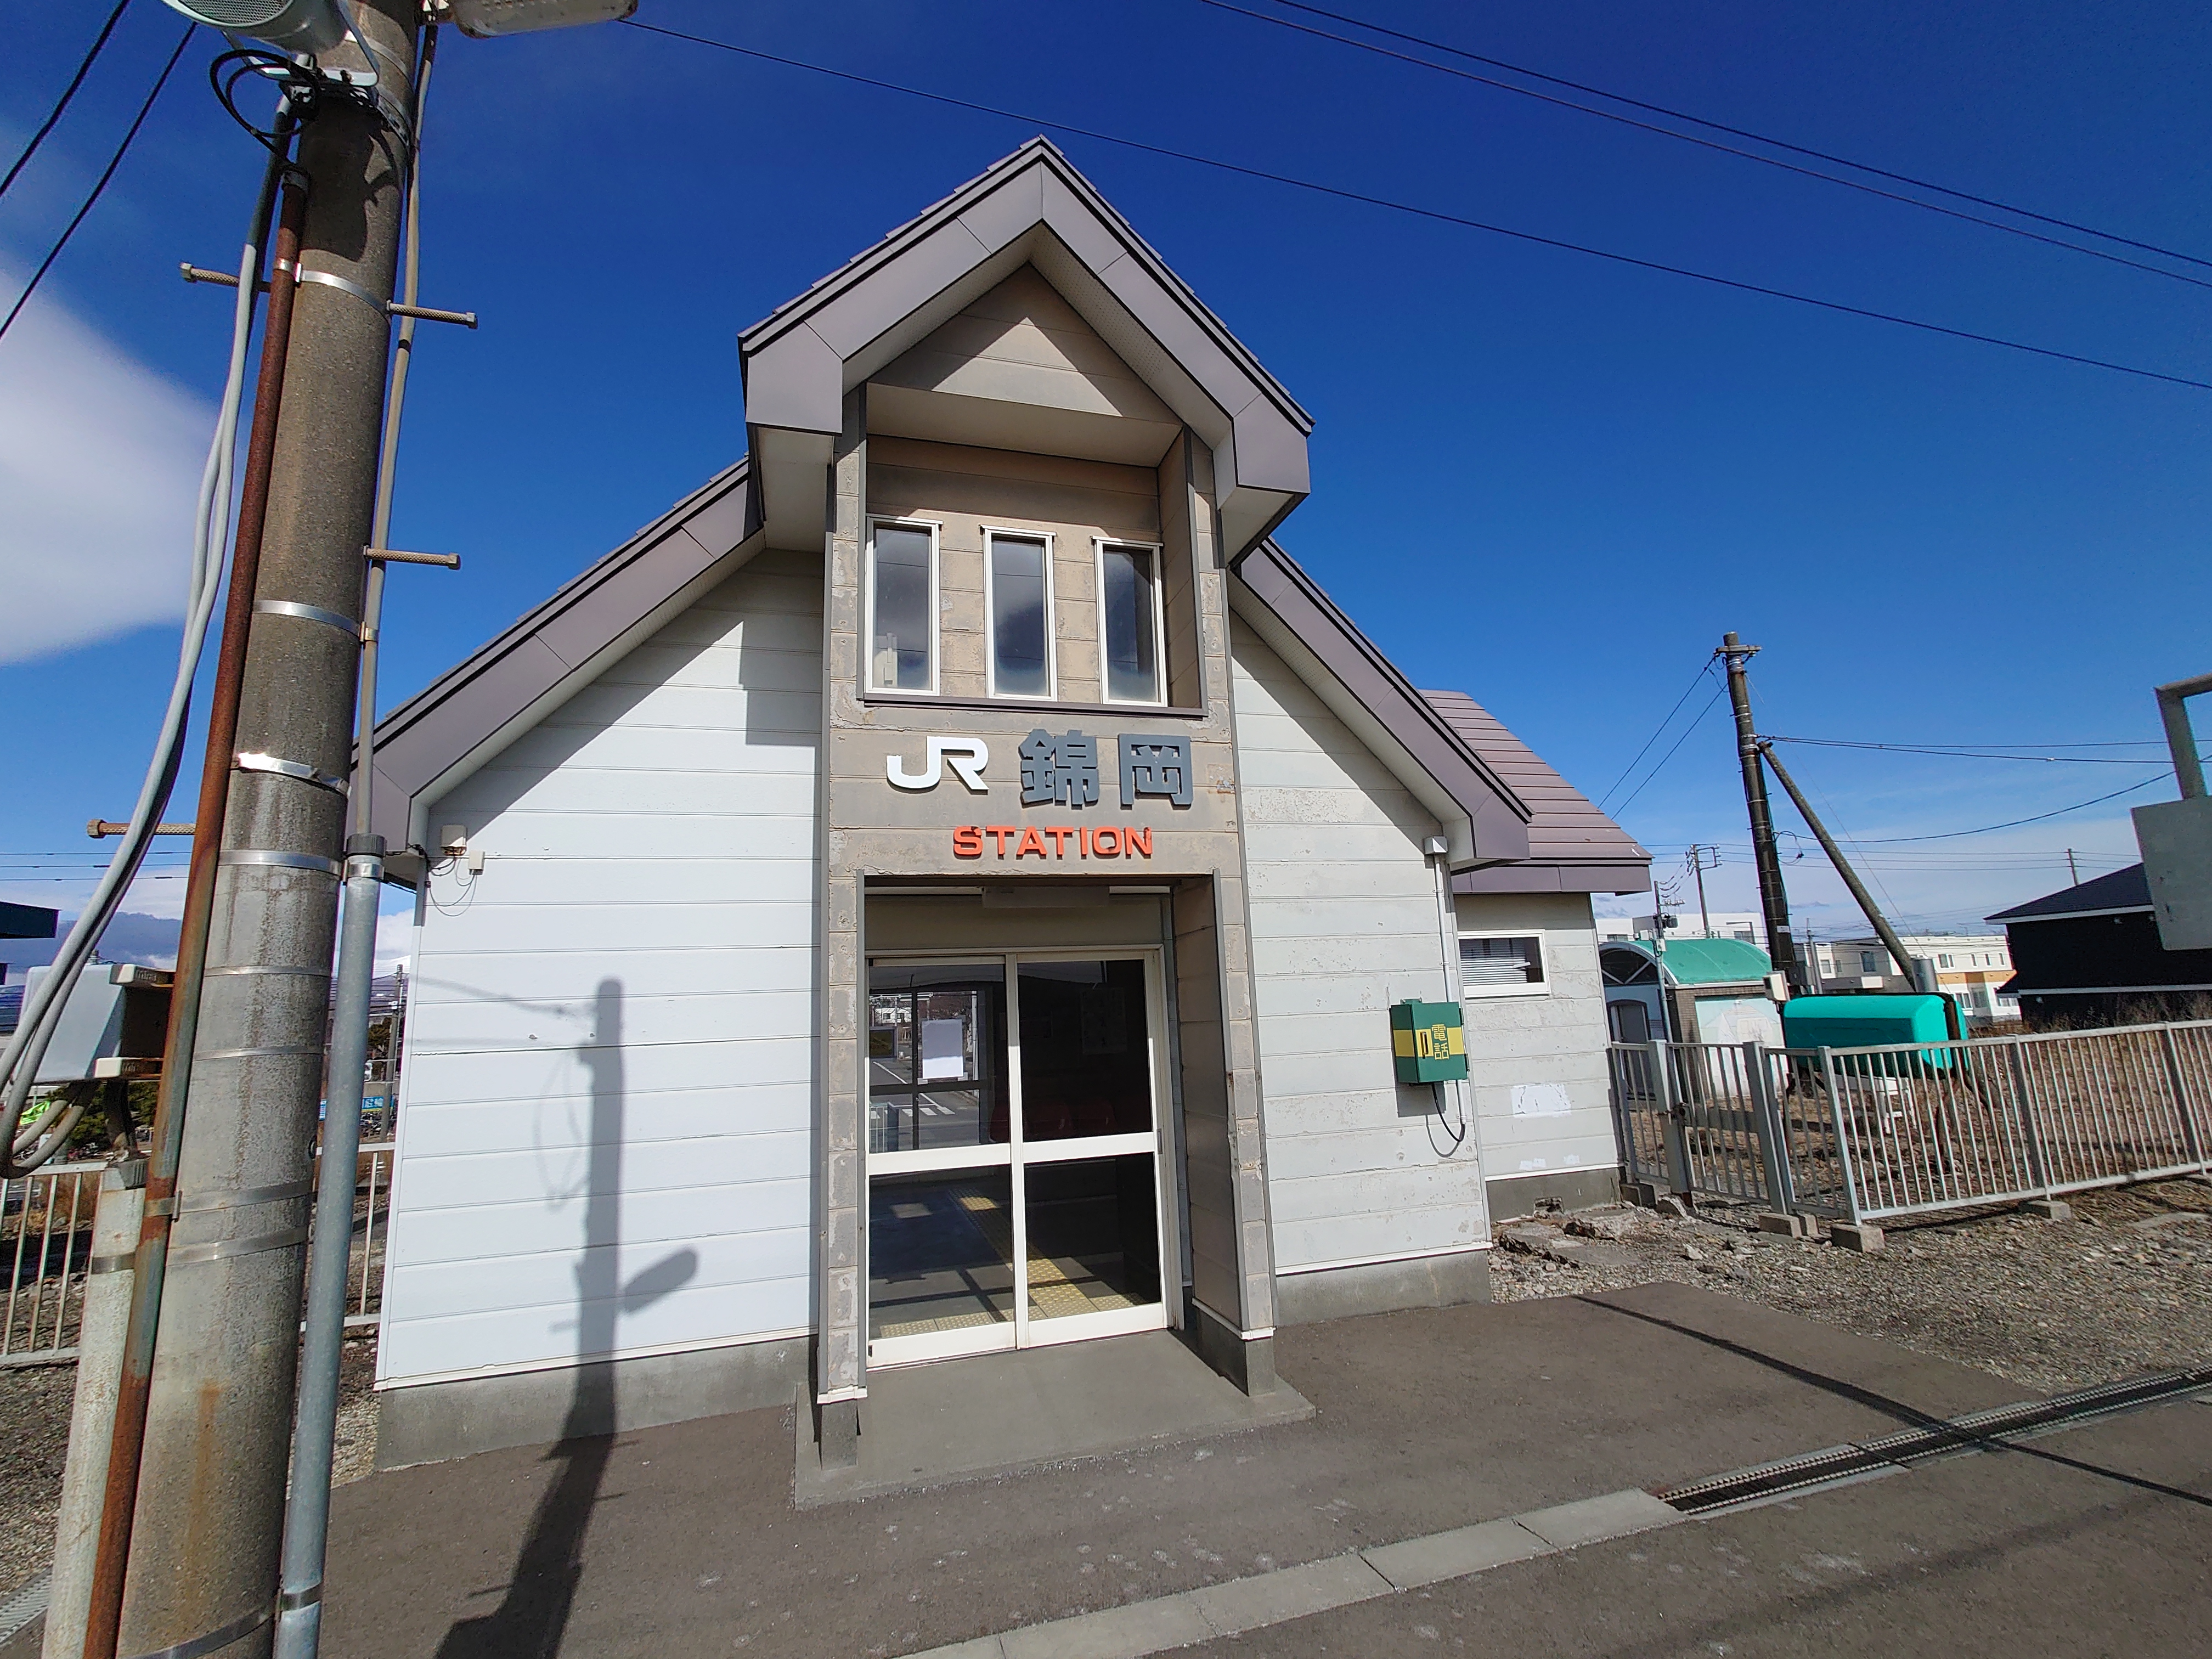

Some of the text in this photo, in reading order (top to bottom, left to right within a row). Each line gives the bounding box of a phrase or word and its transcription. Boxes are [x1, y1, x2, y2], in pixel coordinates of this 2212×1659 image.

[887, 728, 1194, 809] JR 錦岡
[953, 825, 1153, 859] STATION
[1431, 1024, 1449, 1060] 電話
